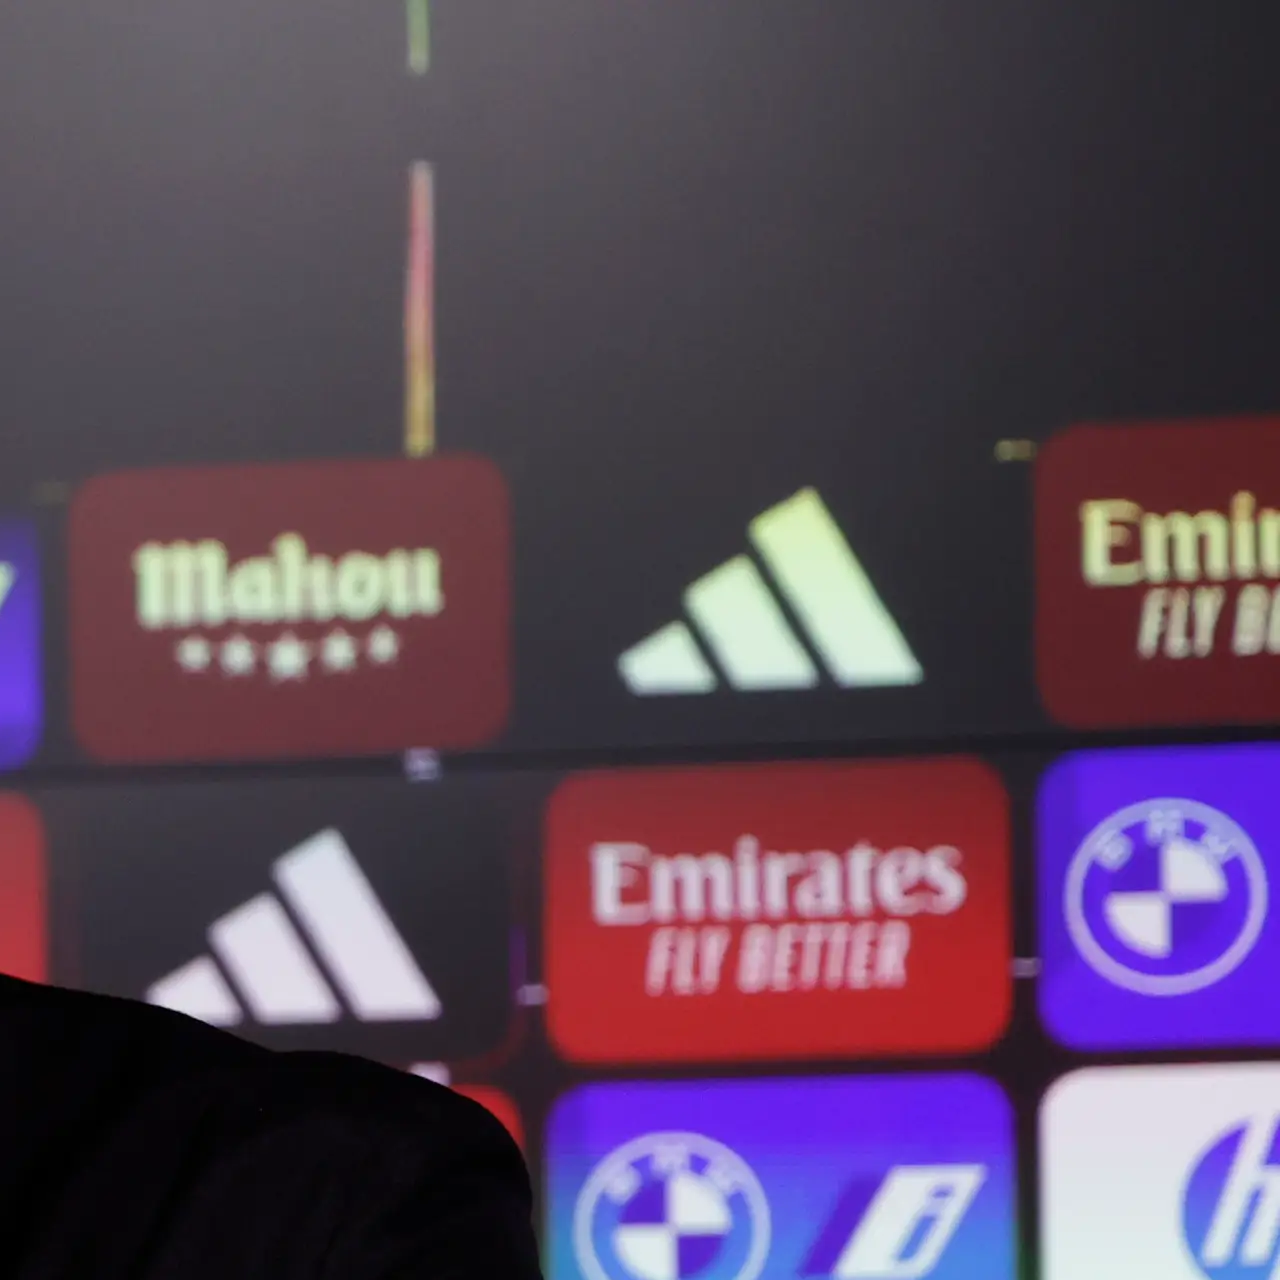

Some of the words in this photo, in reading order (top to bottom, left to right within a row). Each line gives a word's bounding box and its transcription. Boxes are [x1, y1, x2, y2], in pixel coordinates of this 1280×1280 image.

[135, 533, 443, 628] Mahou
[1138, 586, 1225, 660] FLY
[591, 834, 966, 925] Emirates
[646, 926, 731, 996] FLY
[737, 920, 911, 993] BETTER
